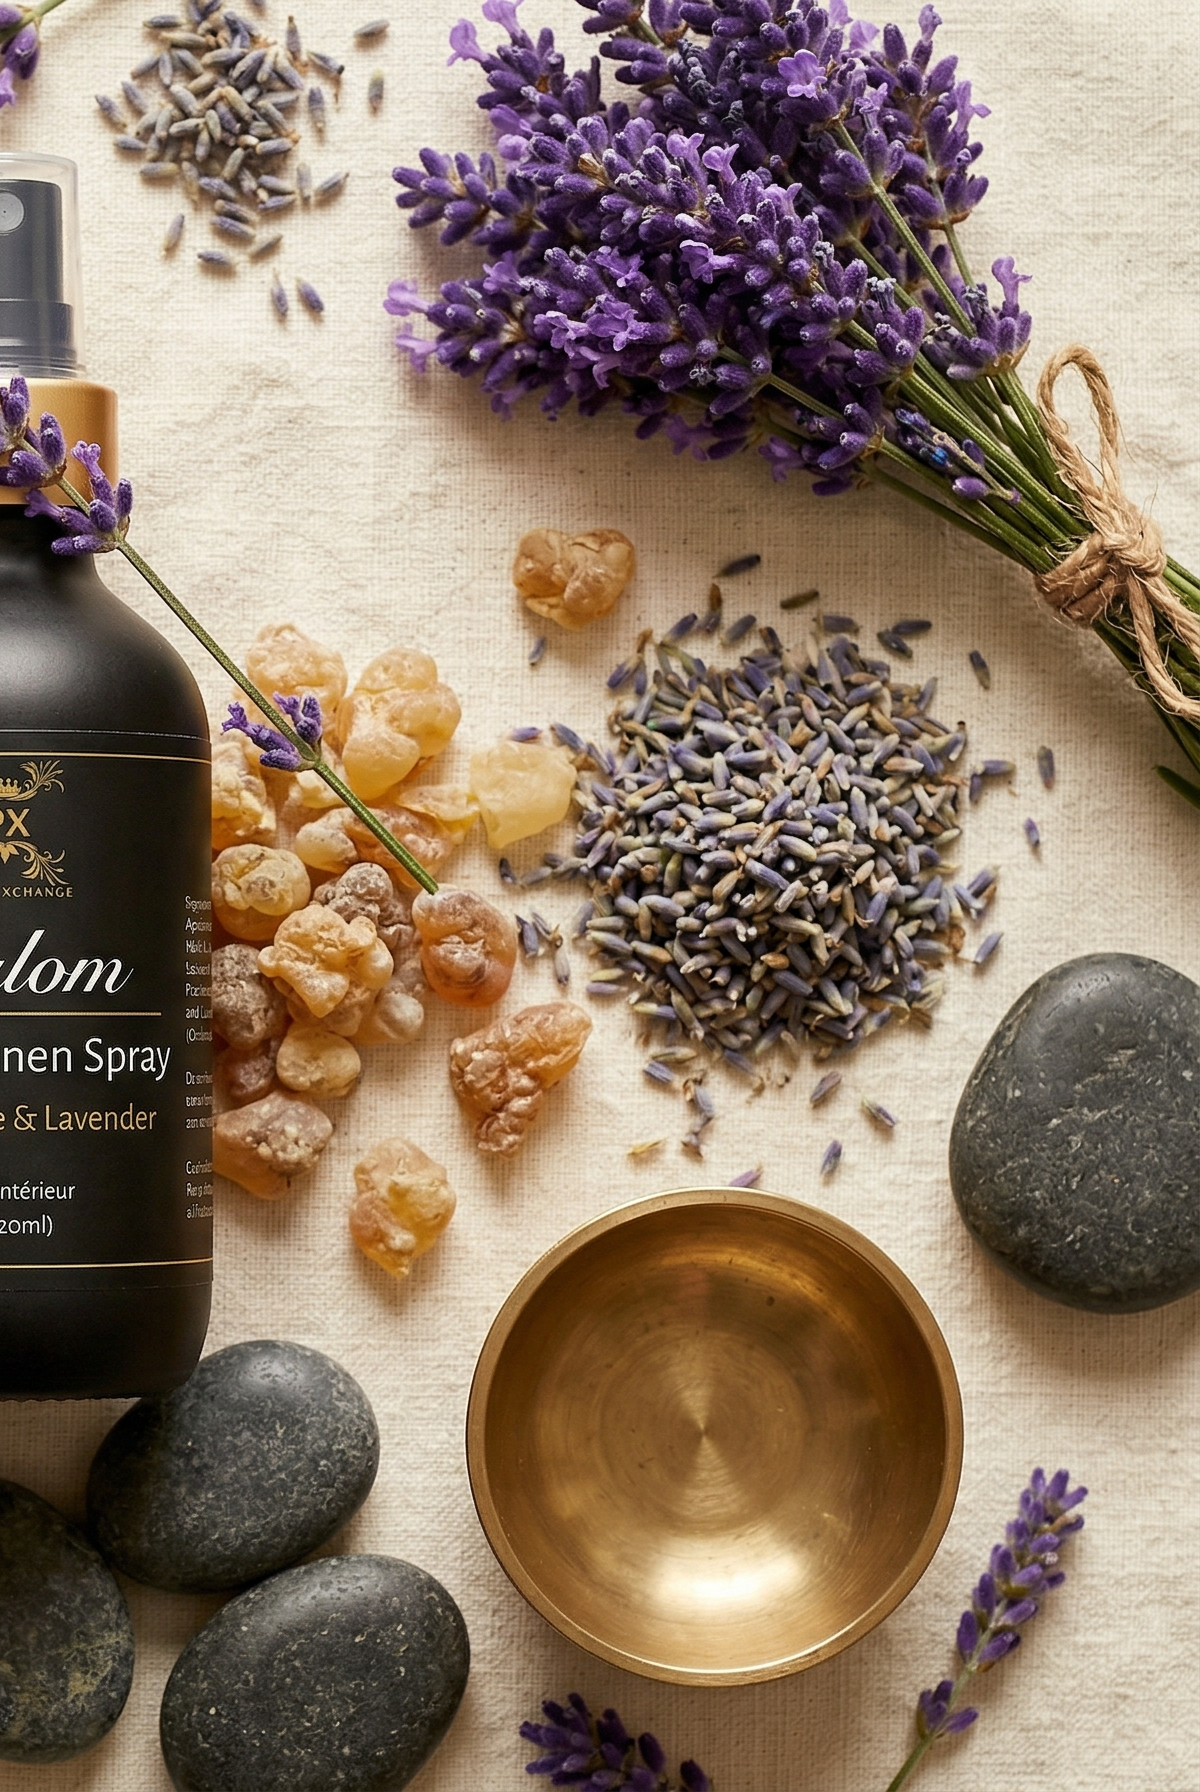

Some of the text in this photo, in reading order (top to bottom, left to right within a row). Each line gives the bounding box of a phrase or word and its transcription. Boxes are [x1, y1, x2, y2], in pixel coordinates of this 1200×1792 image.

[3, 886, 73, 898] XCHANGE
[85, 1038, 171, 1082] Spray
[14, 1104, 37, 1131] &
[46, 1102, 157, 1131] Lavender
